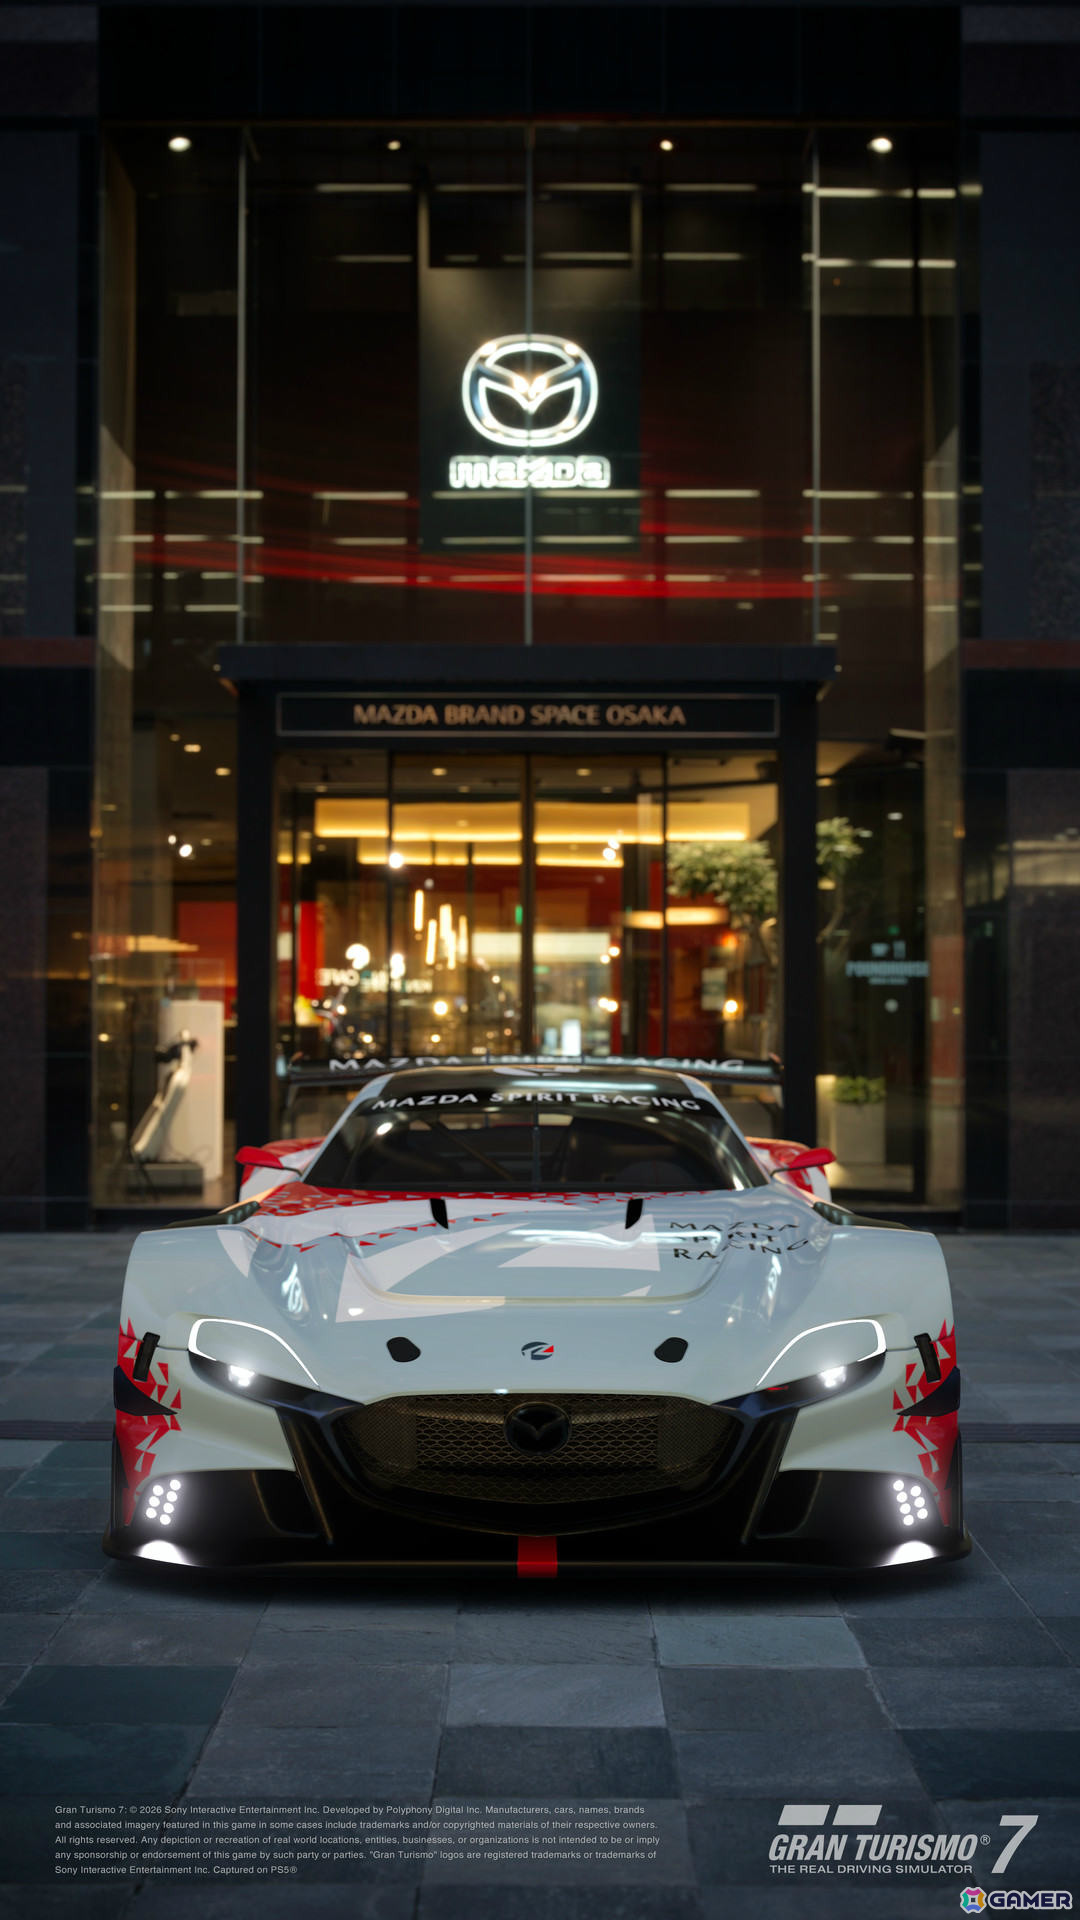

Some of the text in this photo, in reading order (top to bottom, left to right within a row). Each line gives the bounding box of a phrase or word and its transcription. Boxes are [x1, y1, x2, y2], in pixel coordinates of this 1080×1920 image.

[449, 455, 611, 489] mazda
[354, 704, 687, 725] MAZDA BRAND SPACE OSAKA
[372, 1092, 701, 1111] MAZDA SPIRIT RACING
